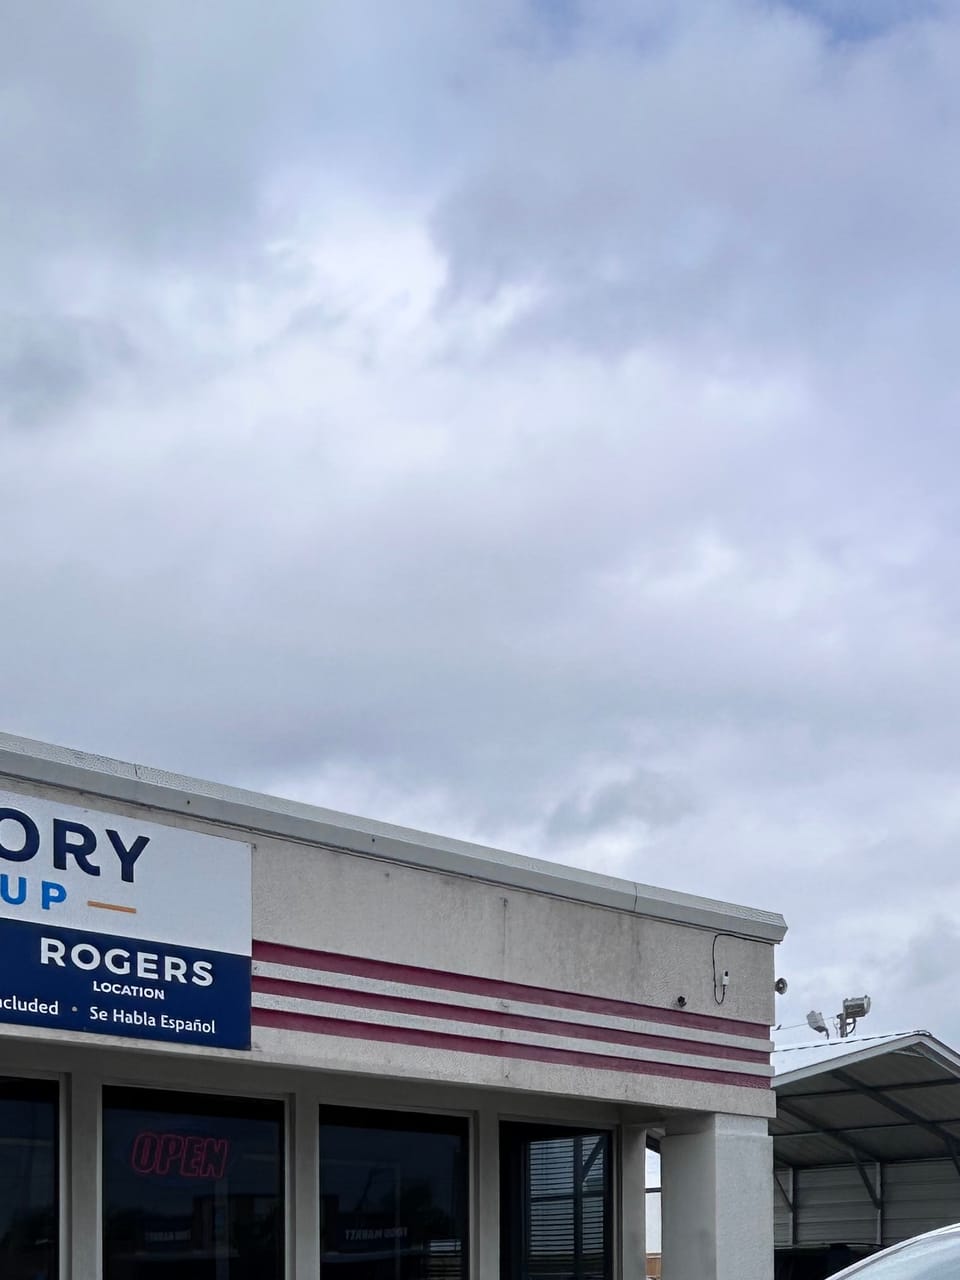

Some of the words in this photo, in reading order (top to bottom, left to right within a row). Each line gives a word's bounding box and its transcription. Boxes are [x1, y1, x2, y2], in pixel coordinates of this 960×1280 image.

[0, 807, 150, 883] ORY
[0, 873, 67, 910] UP
[40, 937, 214, 986] ROGERS
[93, 981, 165, 1000] LOCATION
[0, 995, 59, 1015] cluded
[90, 1006, 108, 1021] Se
[113, 1009, 156, 1026] Habla
[161, 1014, 216, 1034] Español
[132, 1131, 228, 1178] OPEN
